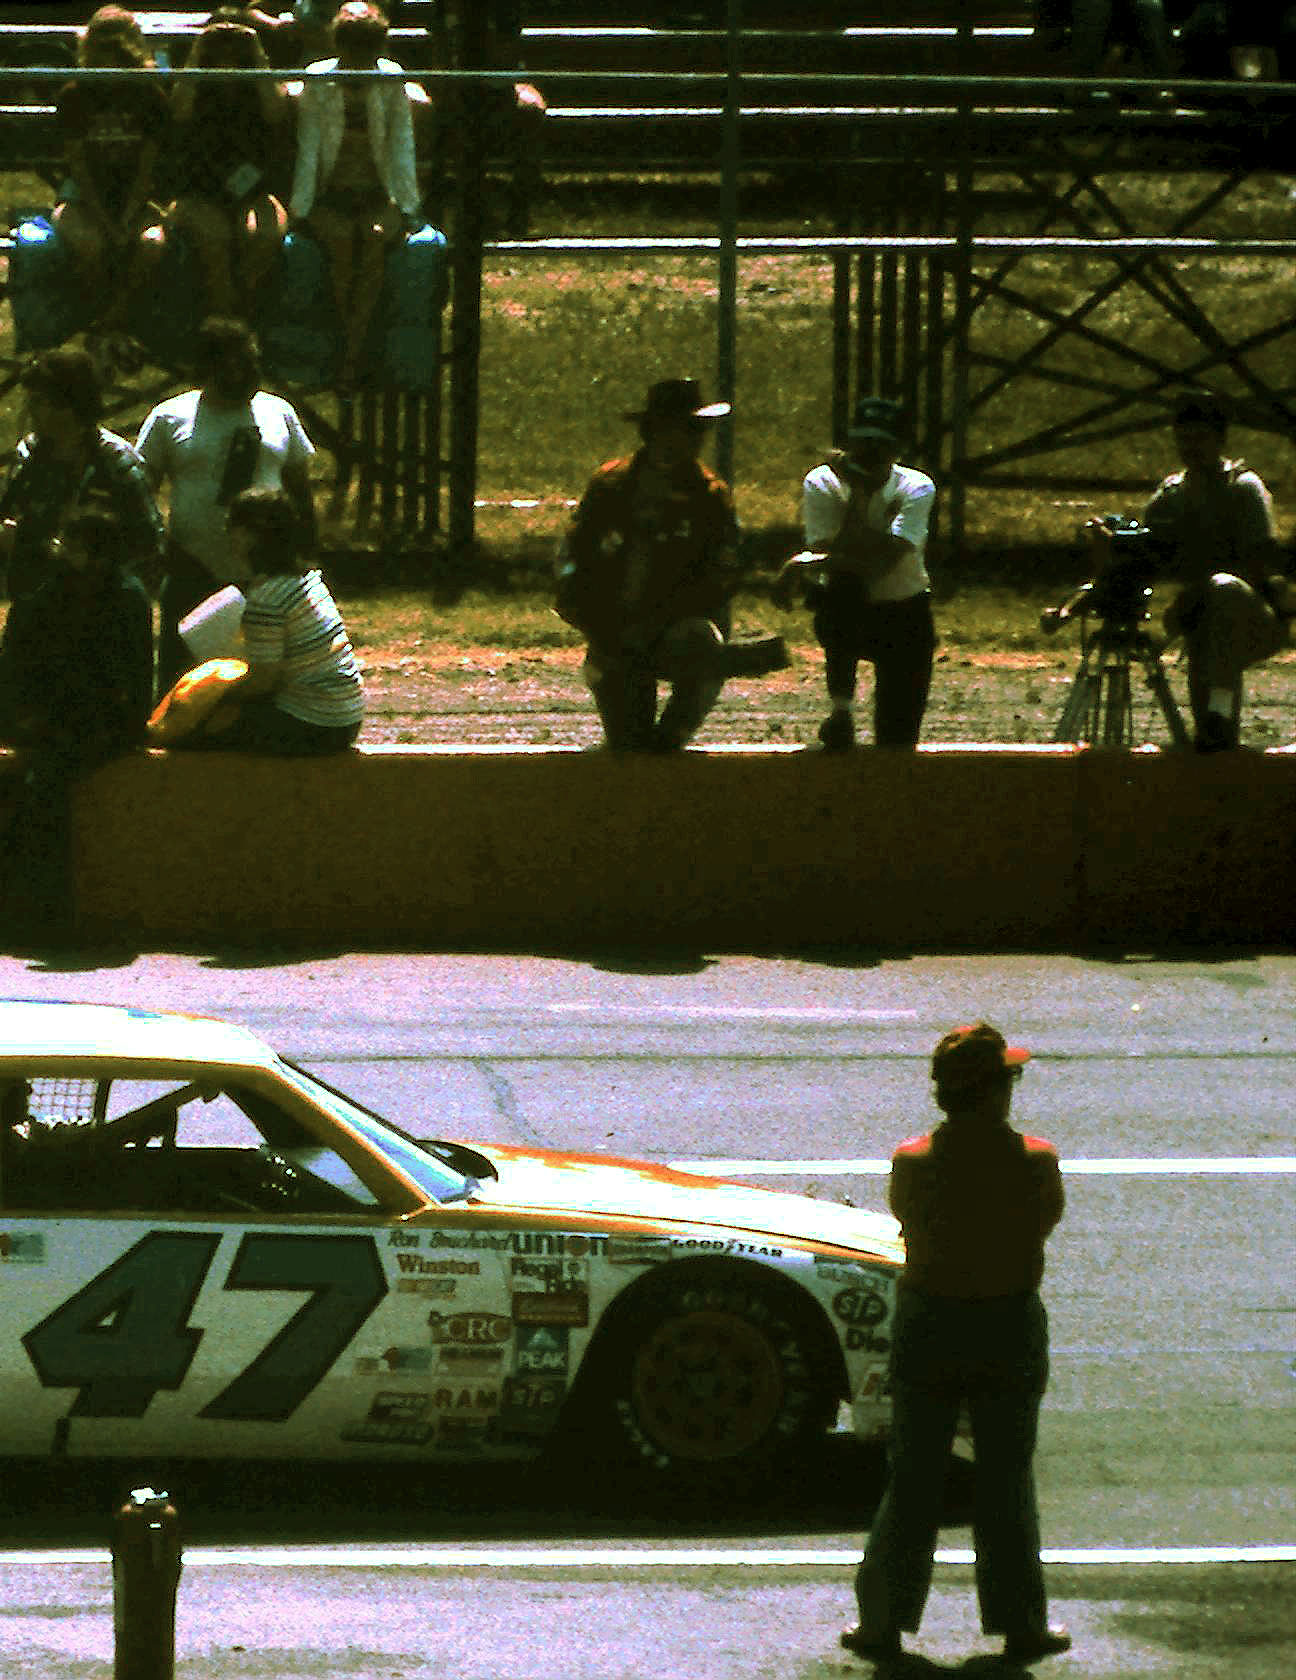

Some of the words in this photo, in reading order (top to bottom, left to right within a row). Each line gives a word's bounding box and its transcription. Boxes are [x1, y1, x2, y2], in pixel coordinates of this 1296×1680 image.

[672, 1239, 783, 1258] GOODYEAR
[397, 1254, 480, 1275] Winston
[836, 1289, 884, 1319] STP
[21, 1230, 389, 1422] 47
[519, 1350, 568, 1370] PEAK
[433, 1388, 498, 1409] RAM
